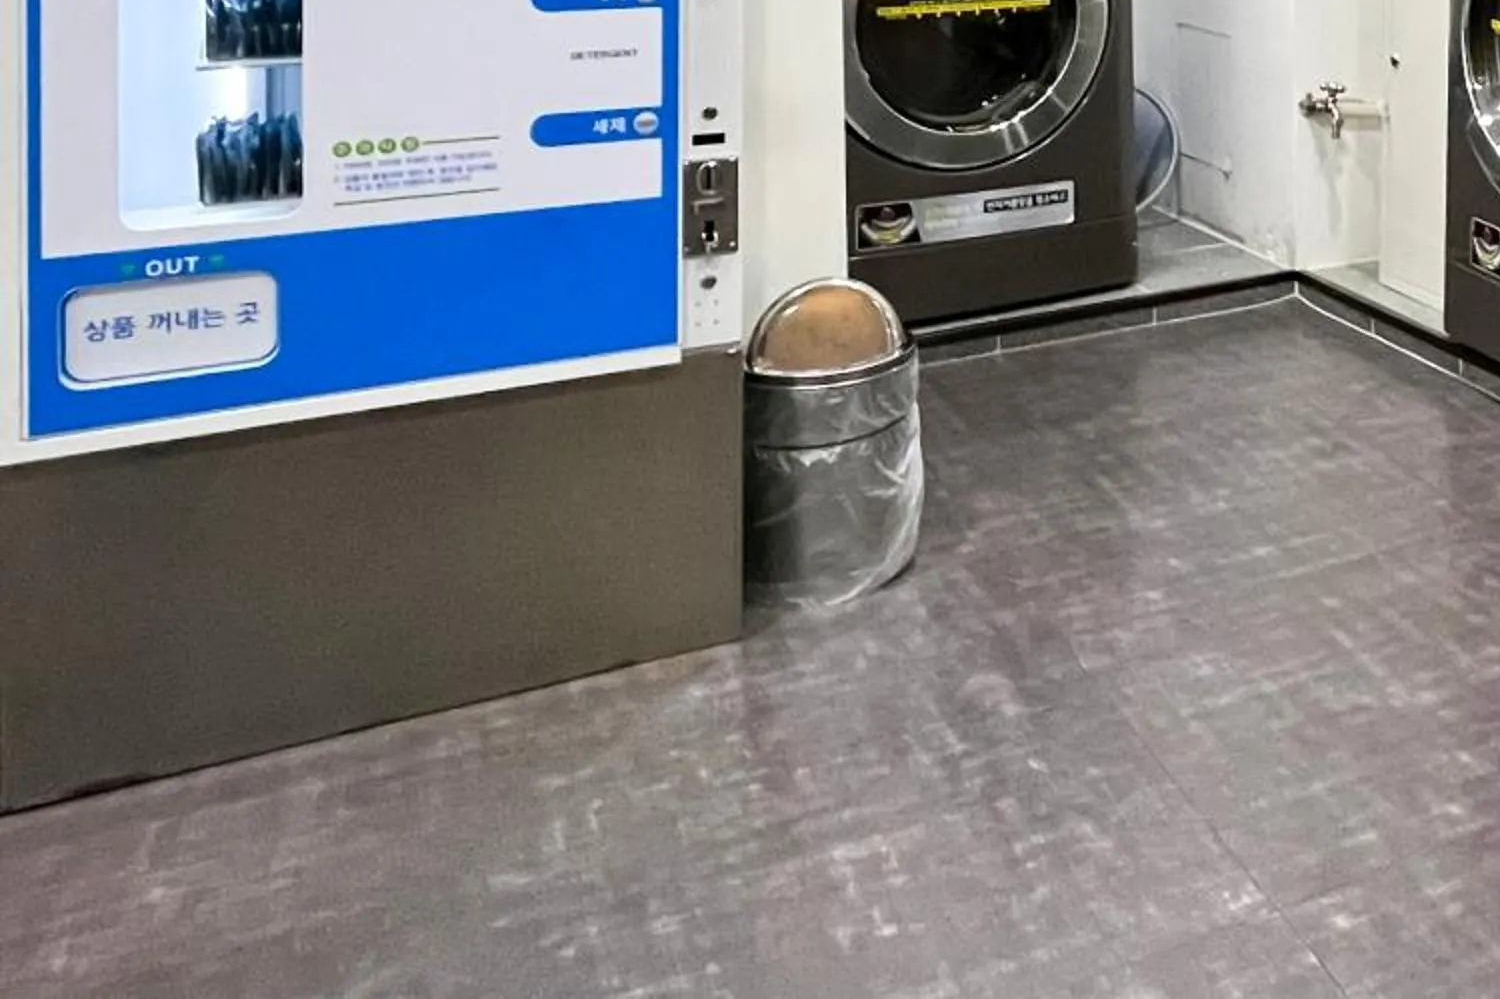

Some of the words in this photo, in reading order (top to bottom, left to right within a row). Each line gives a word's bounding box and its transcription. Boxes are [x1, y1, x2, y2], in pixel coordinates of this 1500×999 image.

[144, 255, 200, 277] OUT
[83, 315, 136, 343] 상품
[147, 308, 226, 334] 꺼내는
[236, 301, 261, 325] 곳
